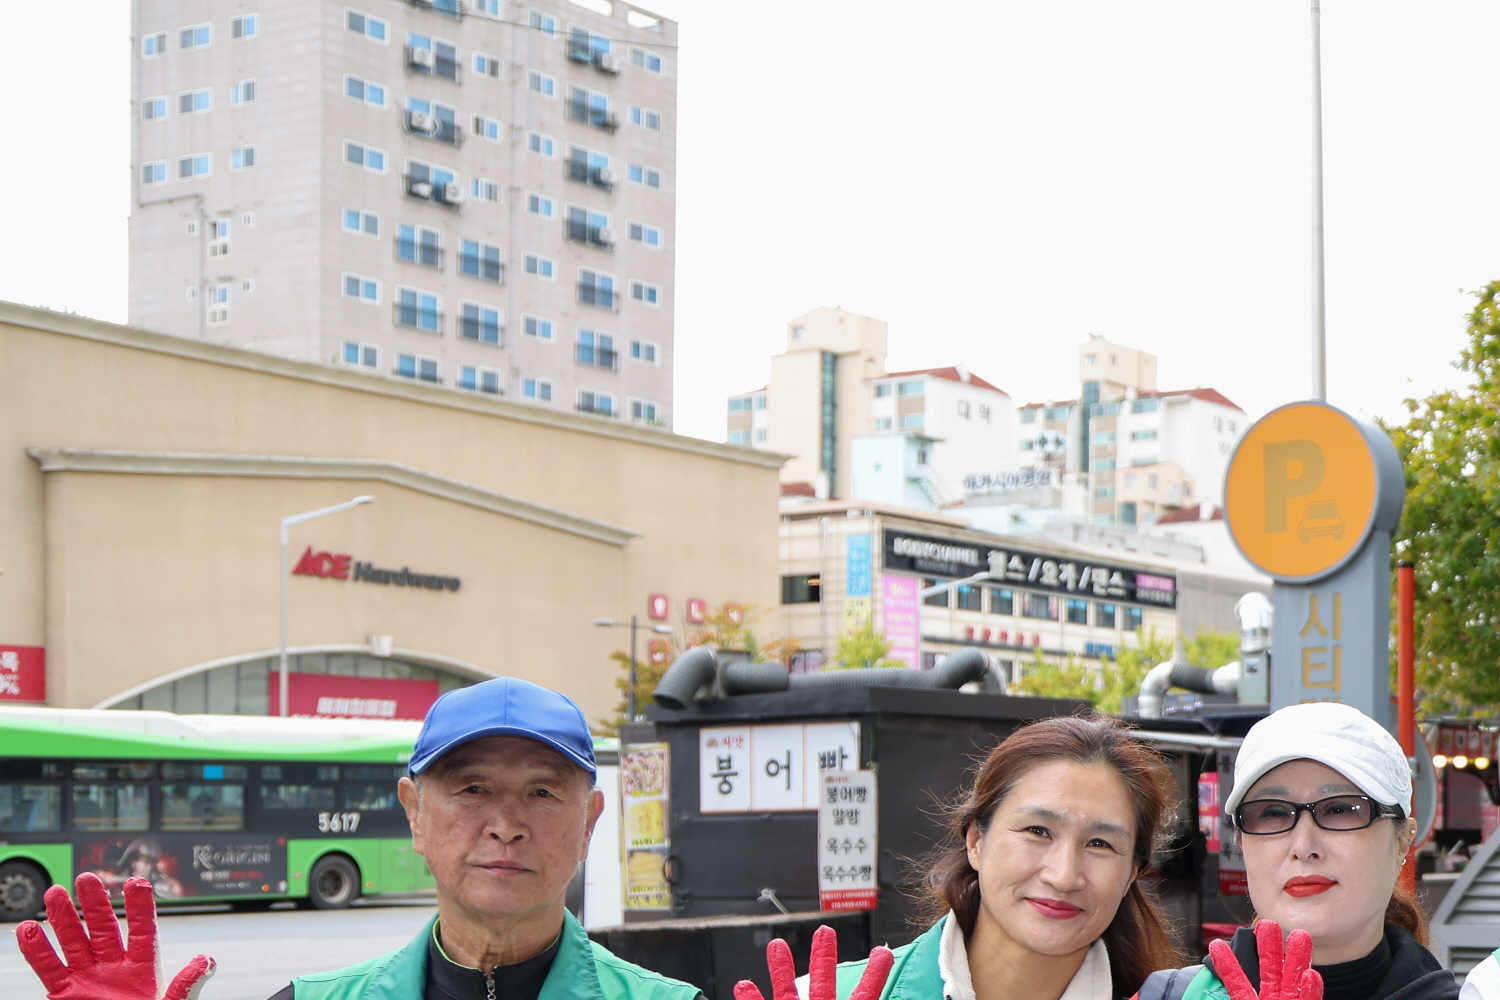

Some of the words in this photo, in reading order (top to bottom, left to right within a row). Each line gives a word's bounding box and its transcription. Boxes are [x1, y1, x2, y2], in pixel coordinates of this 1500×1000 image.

[1262, 438, 1325, 534] P
[292, 545, 353, 581] ACE
[352, 560, 461, 592] Hardware
[1300, 592, 1342, 704] 시티
[825, 786, 867, 803] 붕어빵
[318, 812, 360, 833] 5617
[832, 807, 859, 826] 알밤
[825, 837, 868, 854] 옥수수
[821, 864, 872, 882] 옥수수빵
